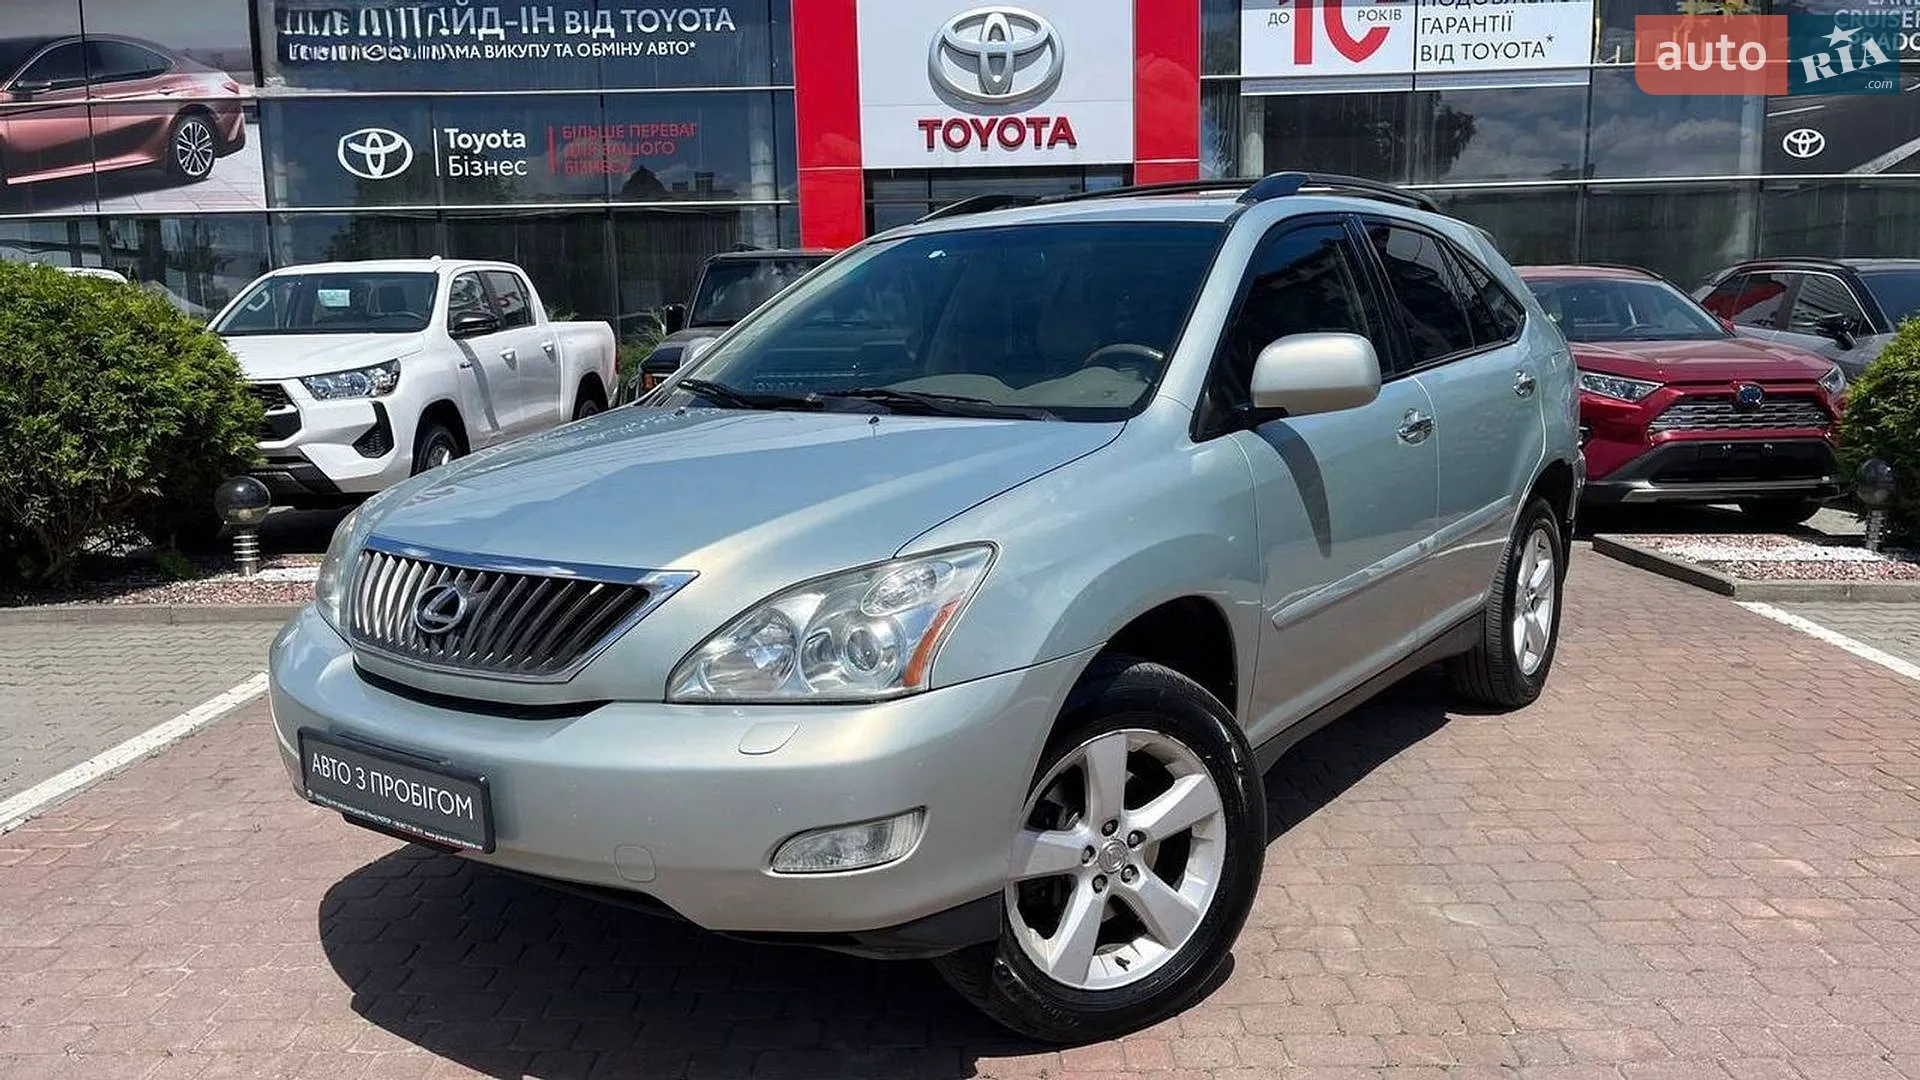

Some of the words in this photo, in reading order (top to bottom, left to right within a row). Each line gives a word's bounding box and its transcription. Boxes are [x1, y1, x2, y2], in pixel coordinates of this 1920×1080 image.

[564, 11, 615, 38] ВІД
[620, 8, 736, 33] TOYOTA
[1268, 12, 1290, 27] ДО
[1357, 9, 1402, 22] РОКІВ
[1421, 10, 1514, 34] ГАРАНТІЇ
[485, 44, 551, 59] ВИКУПУ
[554, 43, 574, 58] ТА
[577, 42, 643, 57] ОБМІНУ
[1420, 44, 1455, 64] ВІД
[444, 128, 526, 154] Toyota
[918, 117, 1077, 151] TOYOTA
[448, 156, 528, 177] Бізнес
[312, 753, 351, 785] АВТО
[371, 771, 474, 820] ПРОБІГОМ
